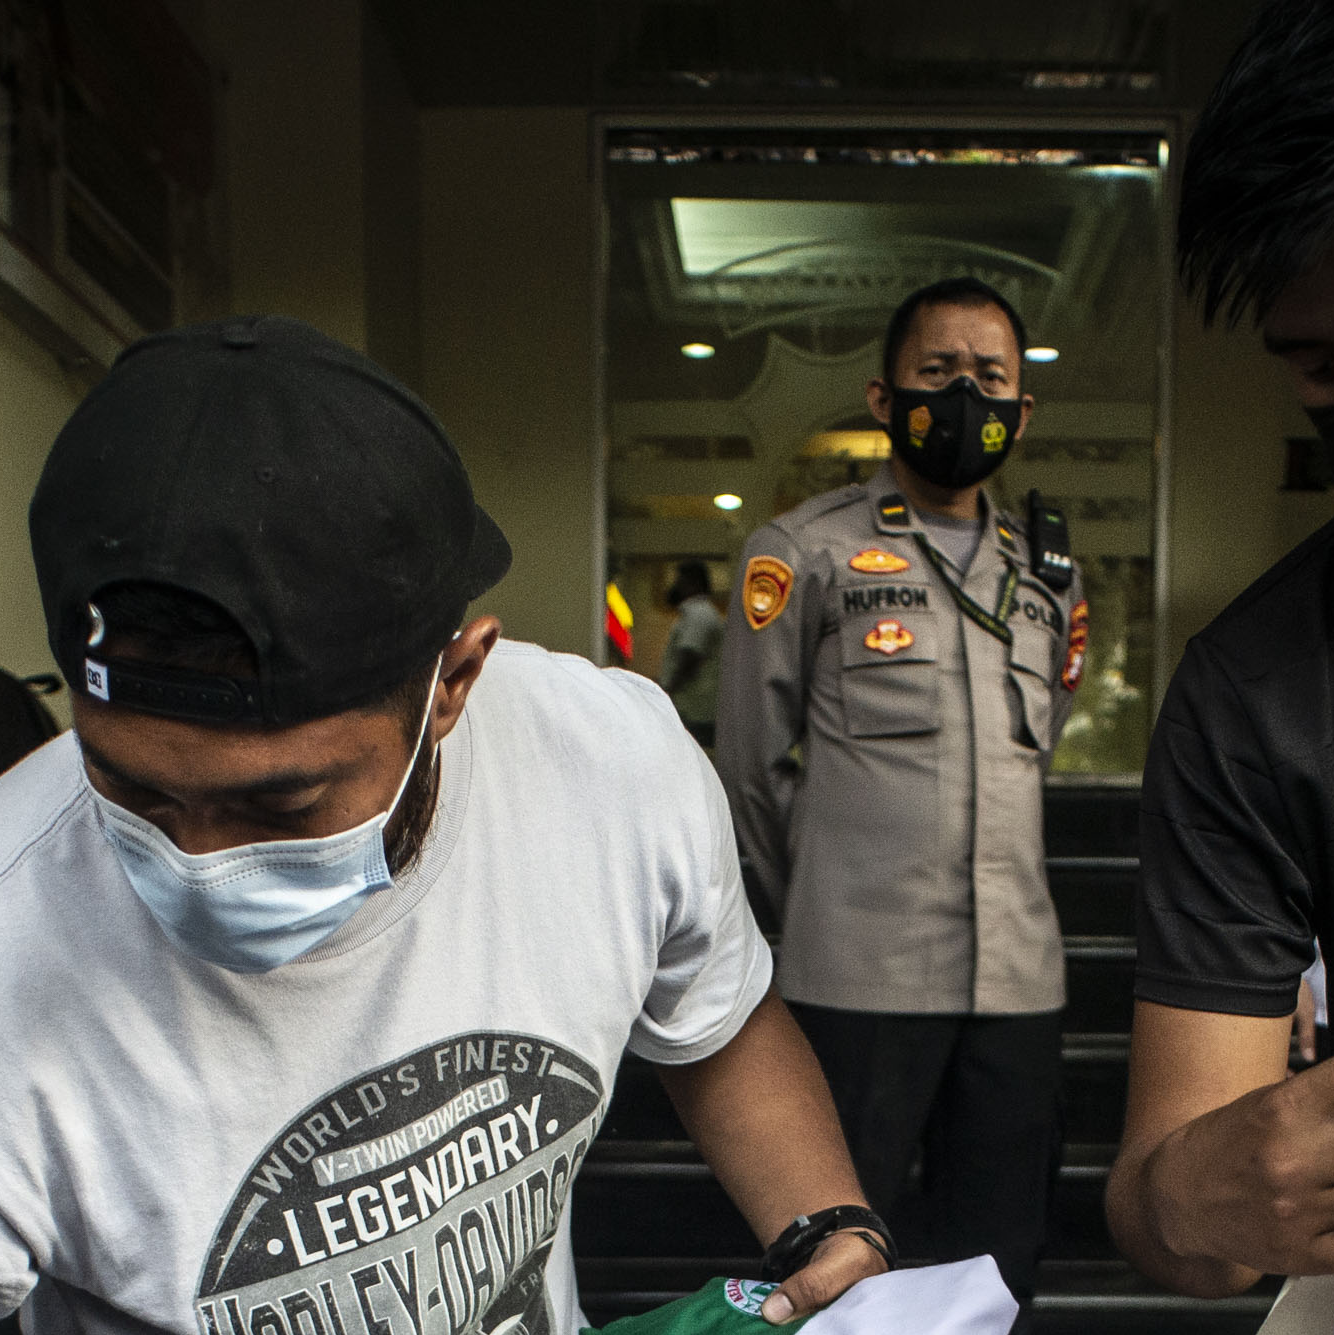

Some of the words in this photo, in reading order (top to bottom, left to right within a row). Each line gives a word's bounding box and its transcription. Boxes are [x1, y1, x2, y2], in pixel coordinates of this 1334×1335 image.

[252, 1062, 421, 1196] WORLD'S
[434, 1040, 555, 1083] FINEST
[283, 1094, 543, 1267] LEGENDARY
[316, 1132, 410, 1183] V-TWIN
[414, 1078, 507, 1148] POWERED
